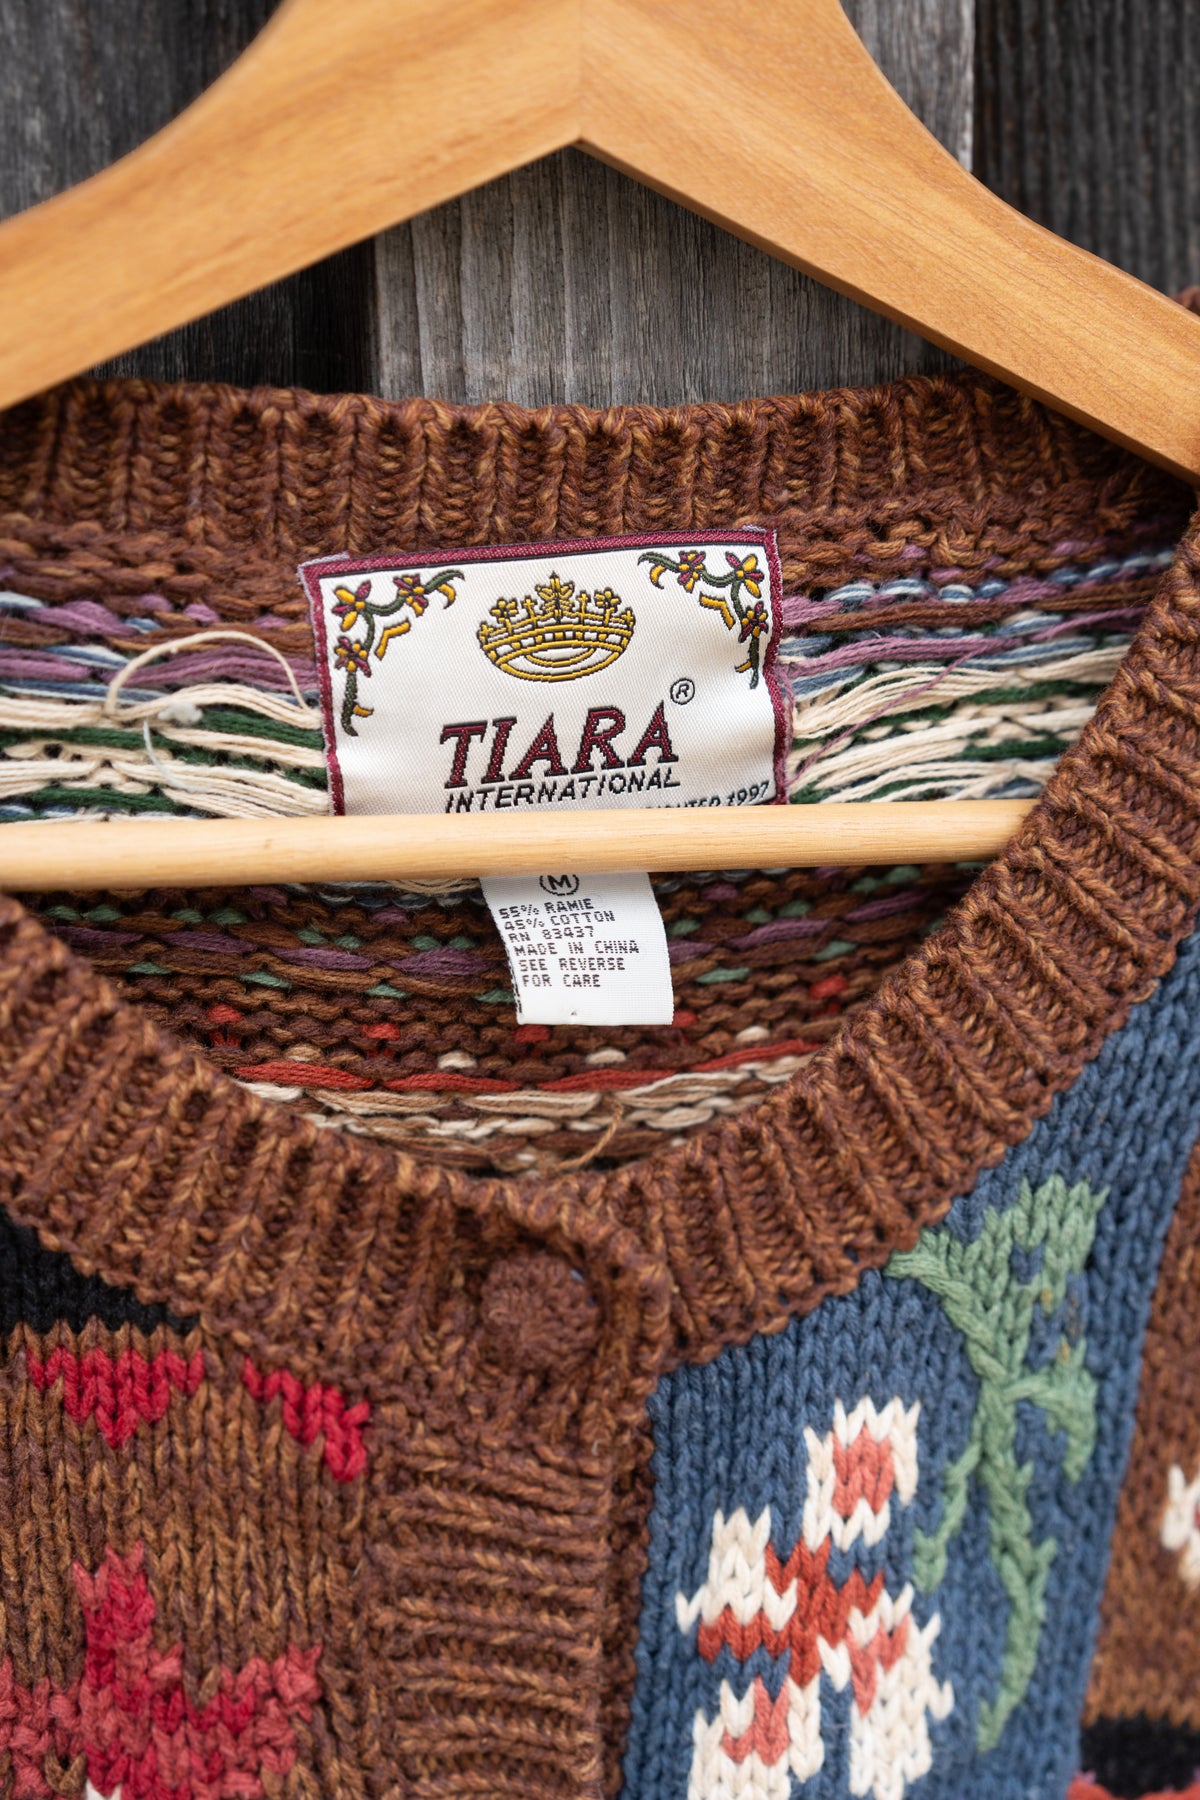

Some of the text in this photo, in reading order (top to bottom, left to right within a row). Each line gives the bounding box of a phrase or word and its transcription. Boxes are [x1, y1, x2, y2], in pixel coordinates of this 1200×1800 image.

[440, 699, 679, 788] TIARA
[445, 767, 681, 814] INTERNATIONAL
[729, 780, 770, 807] 1997
[546, 874, 573, 891] M
[498, 898, 594, 919] 55% RAMIE
[505, 910, 616, 930] 45% COTTON
[508, 925, 594, 943] RN 83437
[514, 940, 640, 956] MADE IN CHINA
[519, 957, 626, 972] SEE REVERSE
[522, 974, 602, 988] FOR CARE
